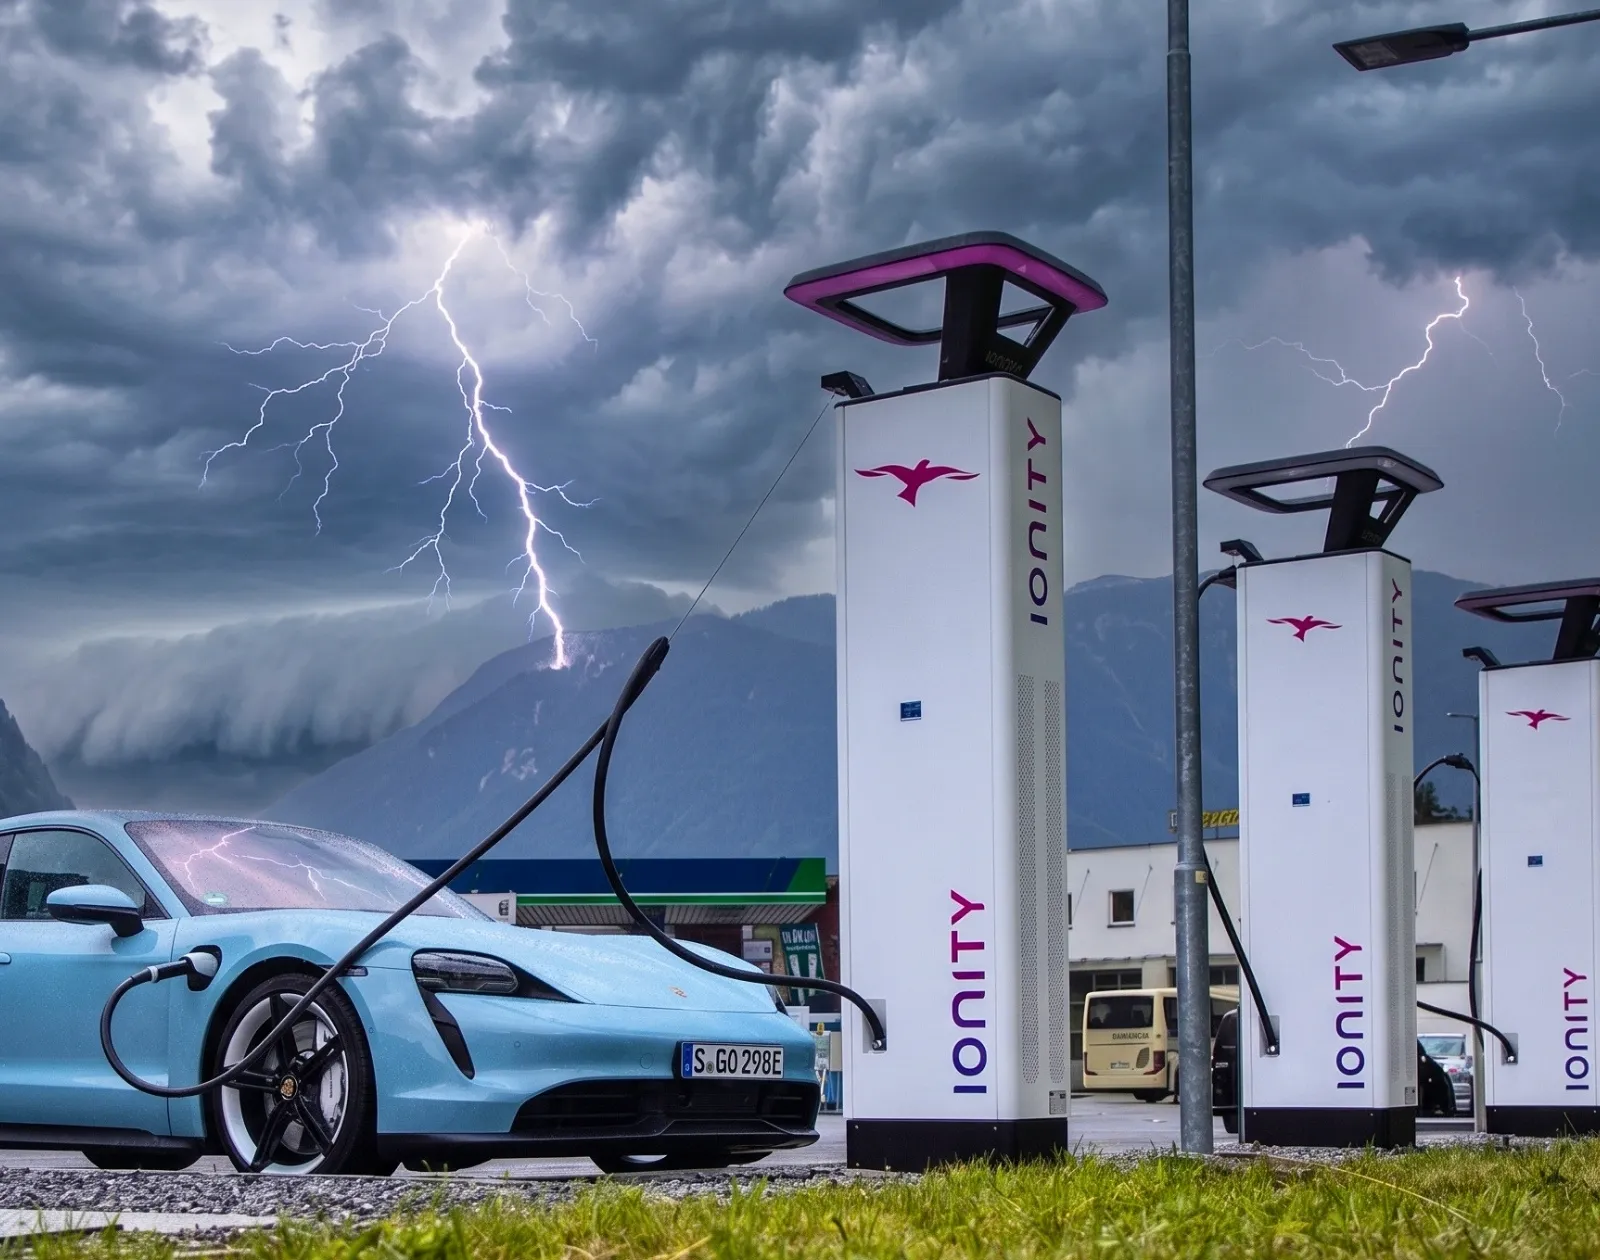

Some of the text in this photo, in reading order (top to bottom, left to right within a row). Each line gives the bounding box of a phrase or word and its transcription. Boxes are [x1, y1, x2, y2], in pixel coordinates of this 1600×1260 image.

[1027, 418, 1048, 626] IONITY
[1391, 578, 1404, 734] IONITY
[693, 1047, 706, 1073] S
[950, 889, 988, 1094] IONITY
[1333, 935, 1365, 1089] IONITY
[1563, 967, 1590, 1091] IONITY
